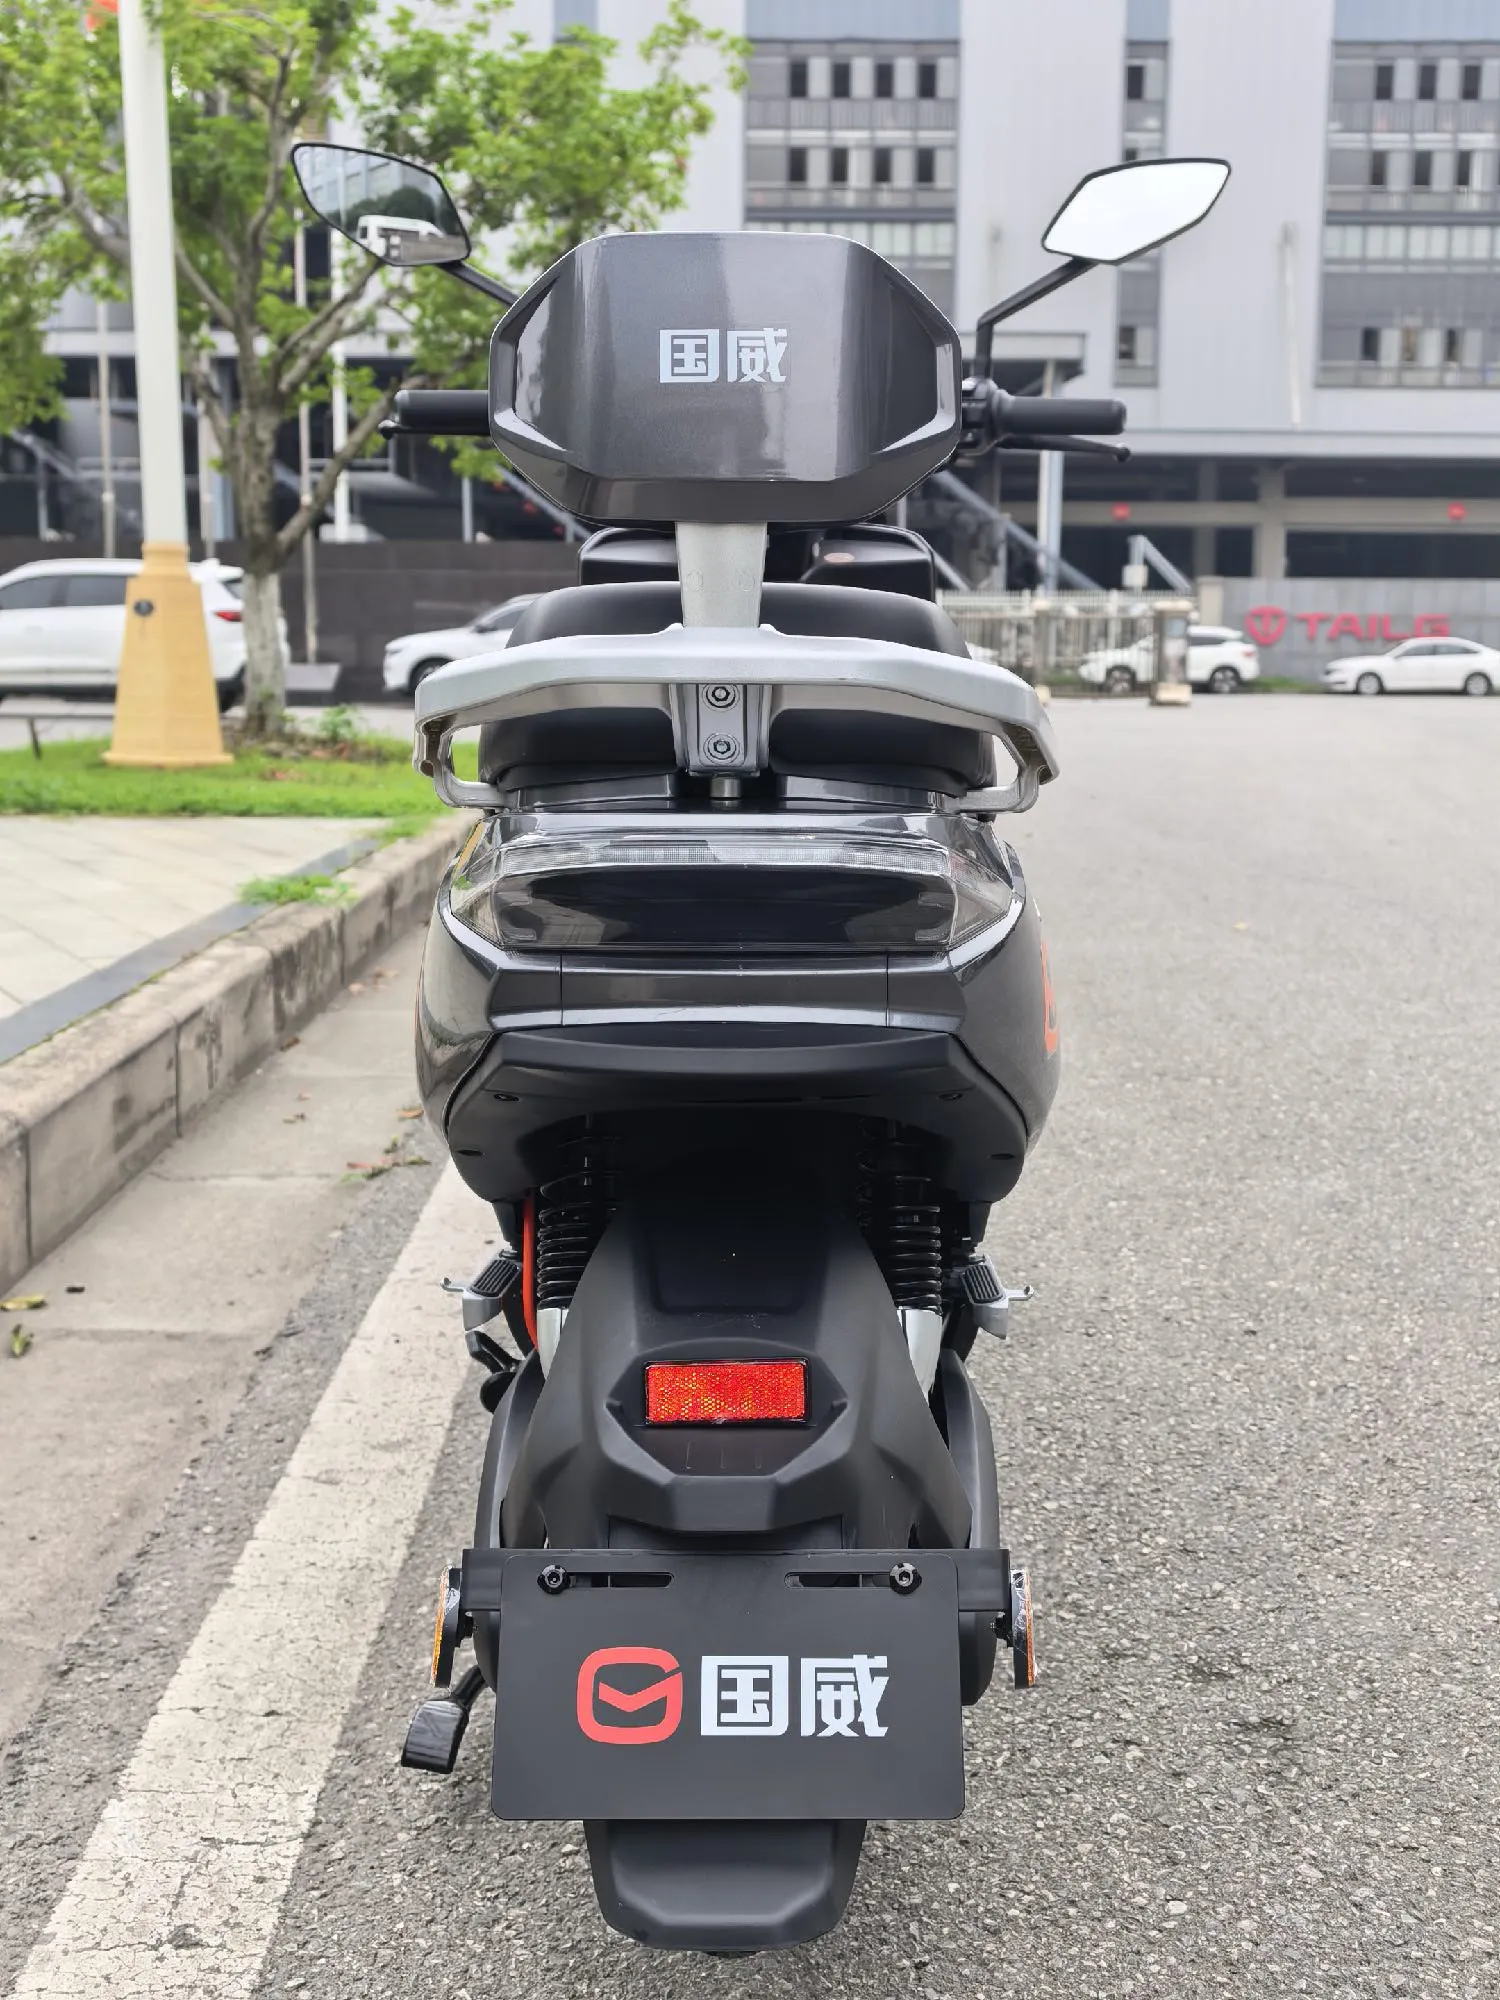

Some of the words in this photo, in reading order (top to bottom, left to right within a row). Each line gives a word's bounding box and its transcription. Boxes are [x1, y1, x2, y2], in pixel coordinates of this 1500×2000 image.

[659, 328, 788, 383] 国威
[1296, 612, 1450, 641] TAILG
[700, 1654, 889, 1738] 国威
